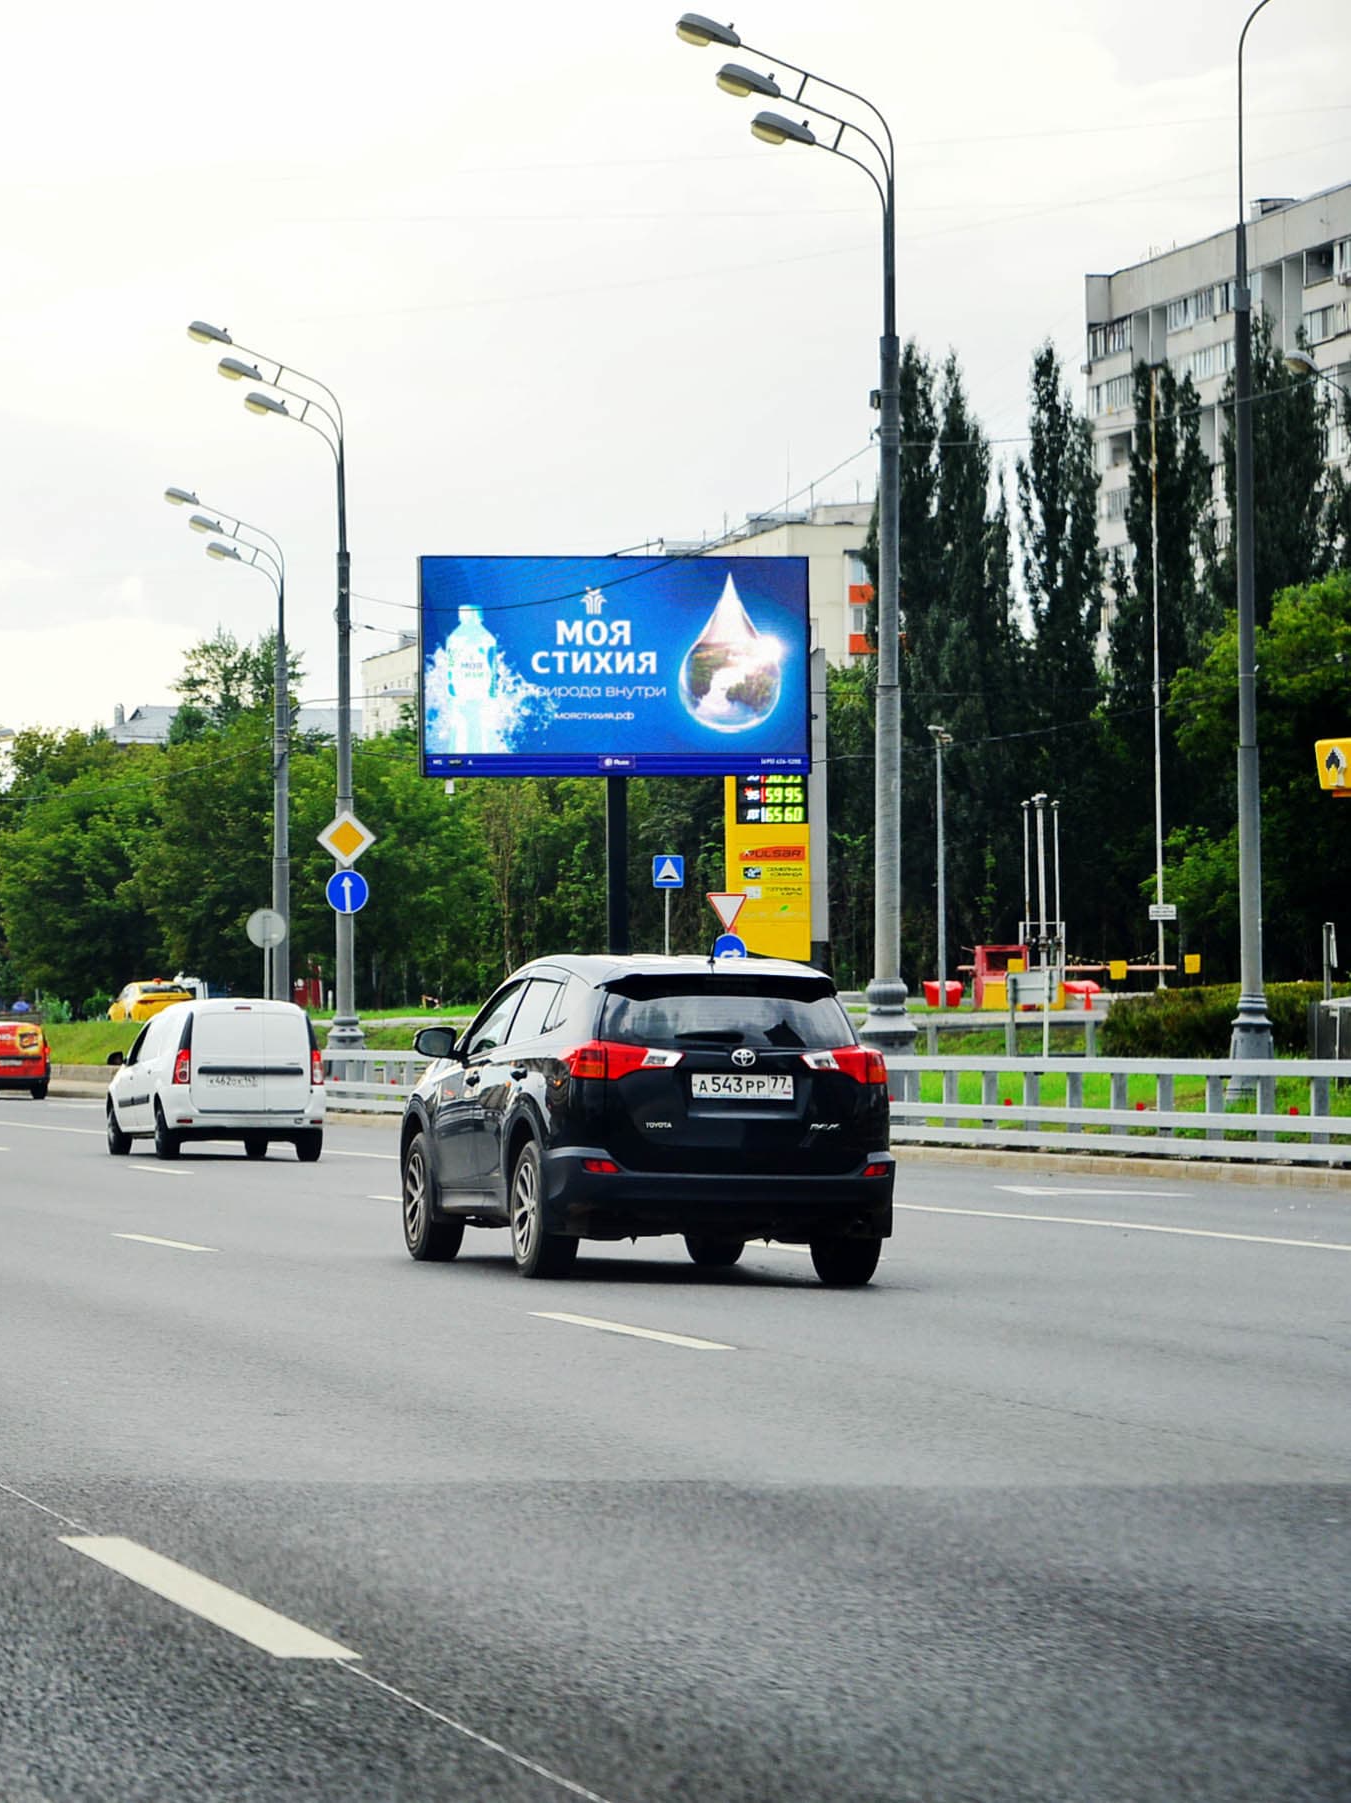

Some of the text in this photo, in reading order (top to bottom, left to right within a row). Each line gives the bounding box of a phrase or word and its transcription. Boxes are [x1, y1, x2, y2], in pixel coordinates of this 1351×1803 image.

[556, 619, 631, 646] МОЯ
[531, 650, 657, 675] СТИХИЯ
[605, 685, 667, 700] внутри
[699, 1076, 787, 1094] А543РР 77
[645, 1121, 673, 1129] TOYOTA
